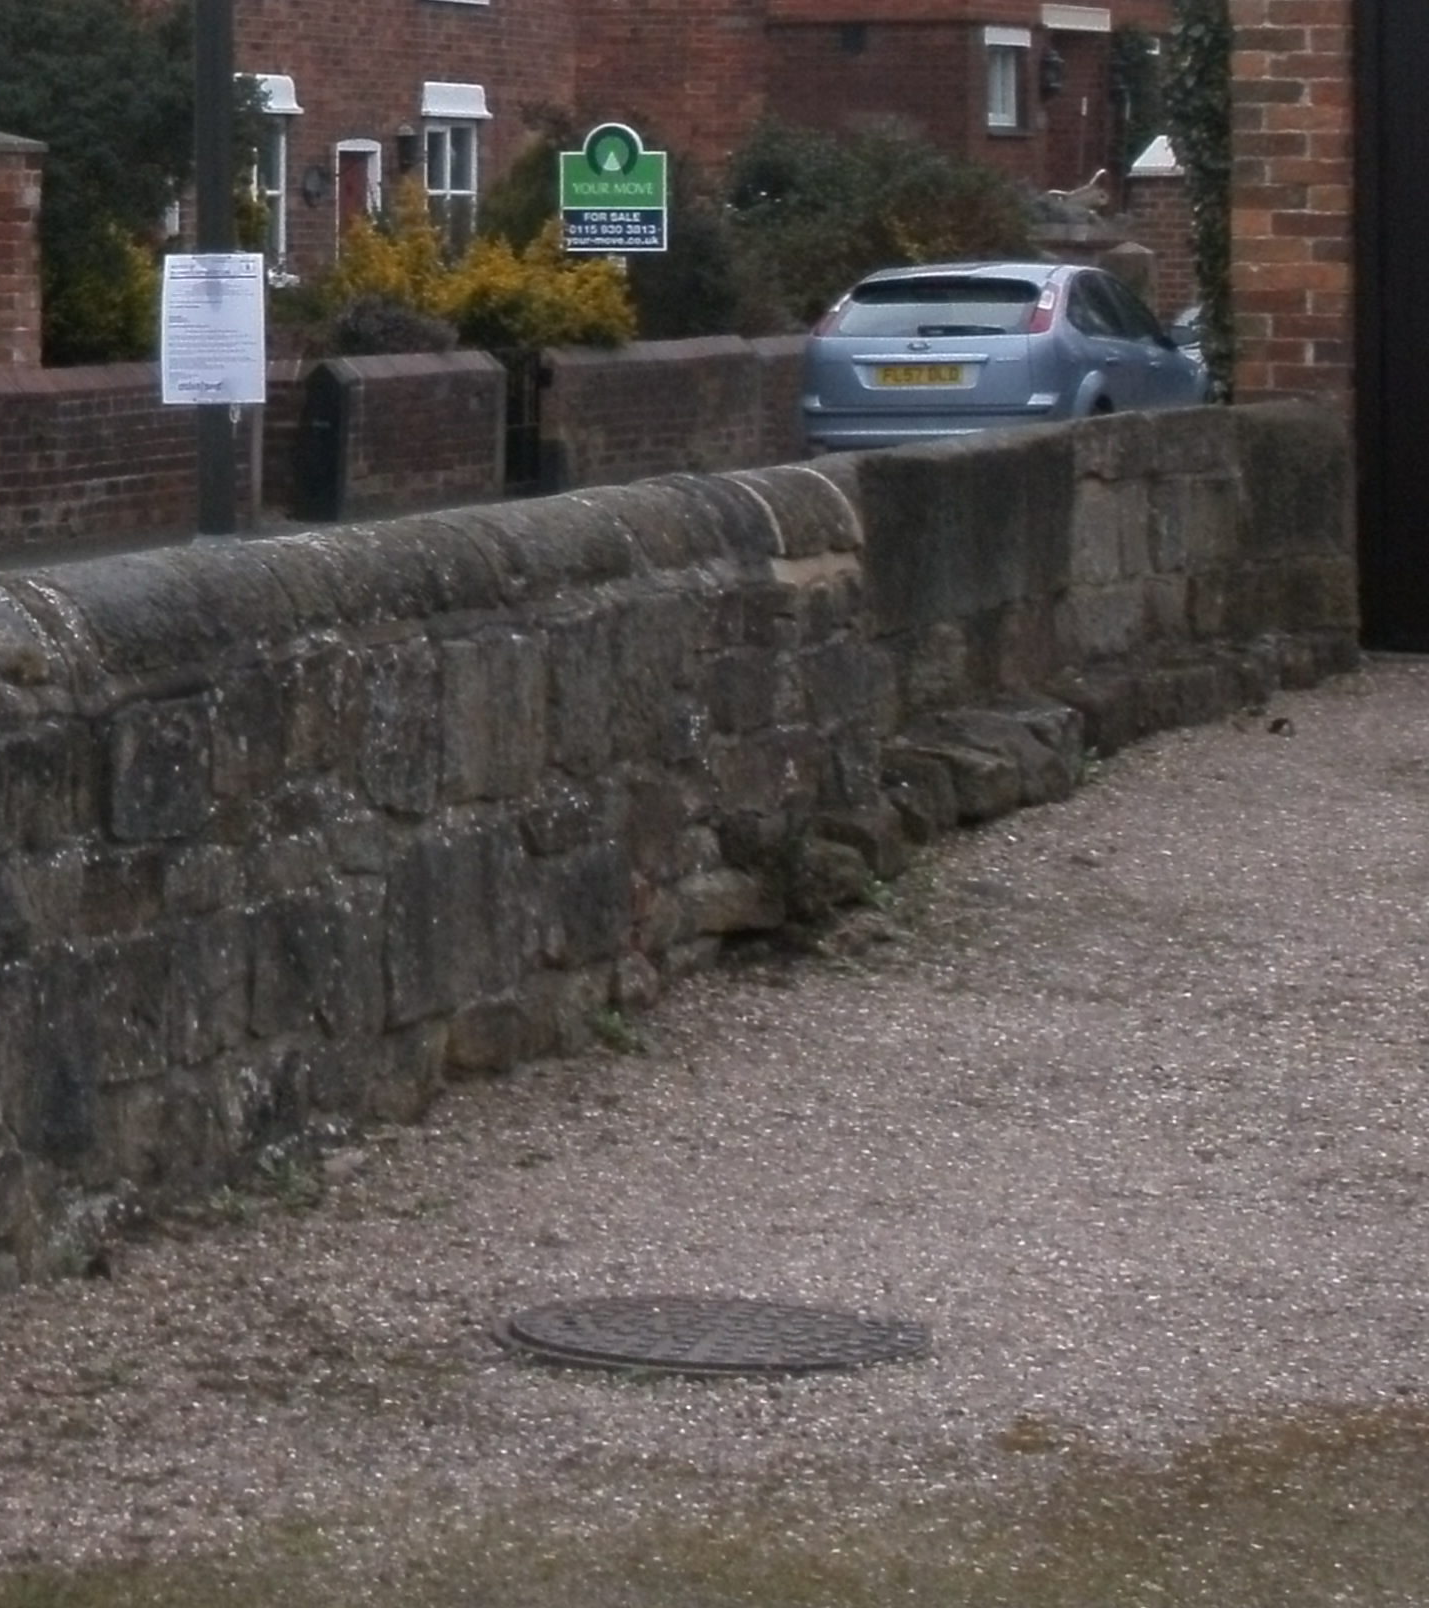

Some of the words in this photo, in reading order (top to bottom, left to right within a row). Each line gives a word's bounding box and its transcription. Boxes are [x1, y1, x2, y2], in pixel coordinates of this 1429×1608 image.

[572, 182, 609, 195] YOUR
[614, 182, 653, 195] MOVE
[583, 212, 607, 222] FOR
[610, 212, 641, 222] SALE
